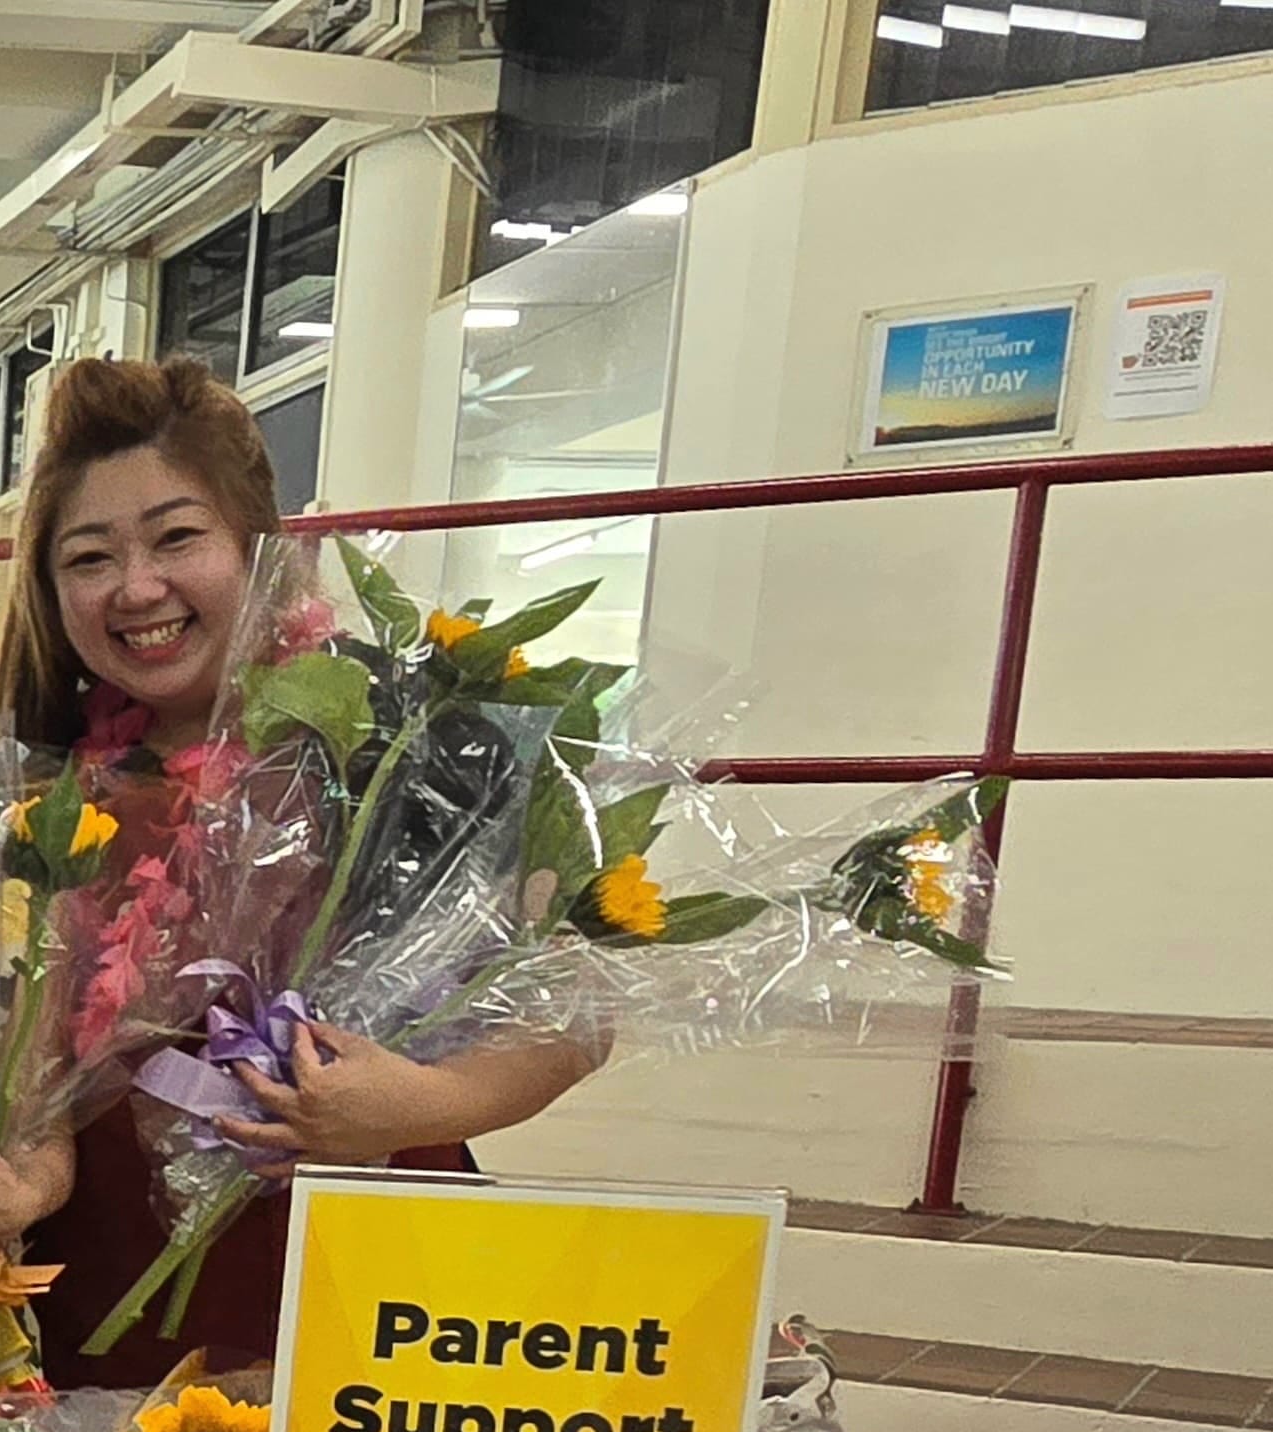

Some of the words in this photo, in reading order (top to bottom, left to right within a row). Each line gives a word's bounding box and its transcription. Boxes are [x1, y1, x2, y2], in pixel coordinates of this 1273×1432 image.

[923, 338, 1035, 364] OPPORTUNITY
[921, 364, 939, 380] IN
[942, 360, 985, 378] EACH
[918, 376, 975, 400] NEW
[981, 369, 1029, 394] DAY
[373, 1301, 671, 1376] Parent
